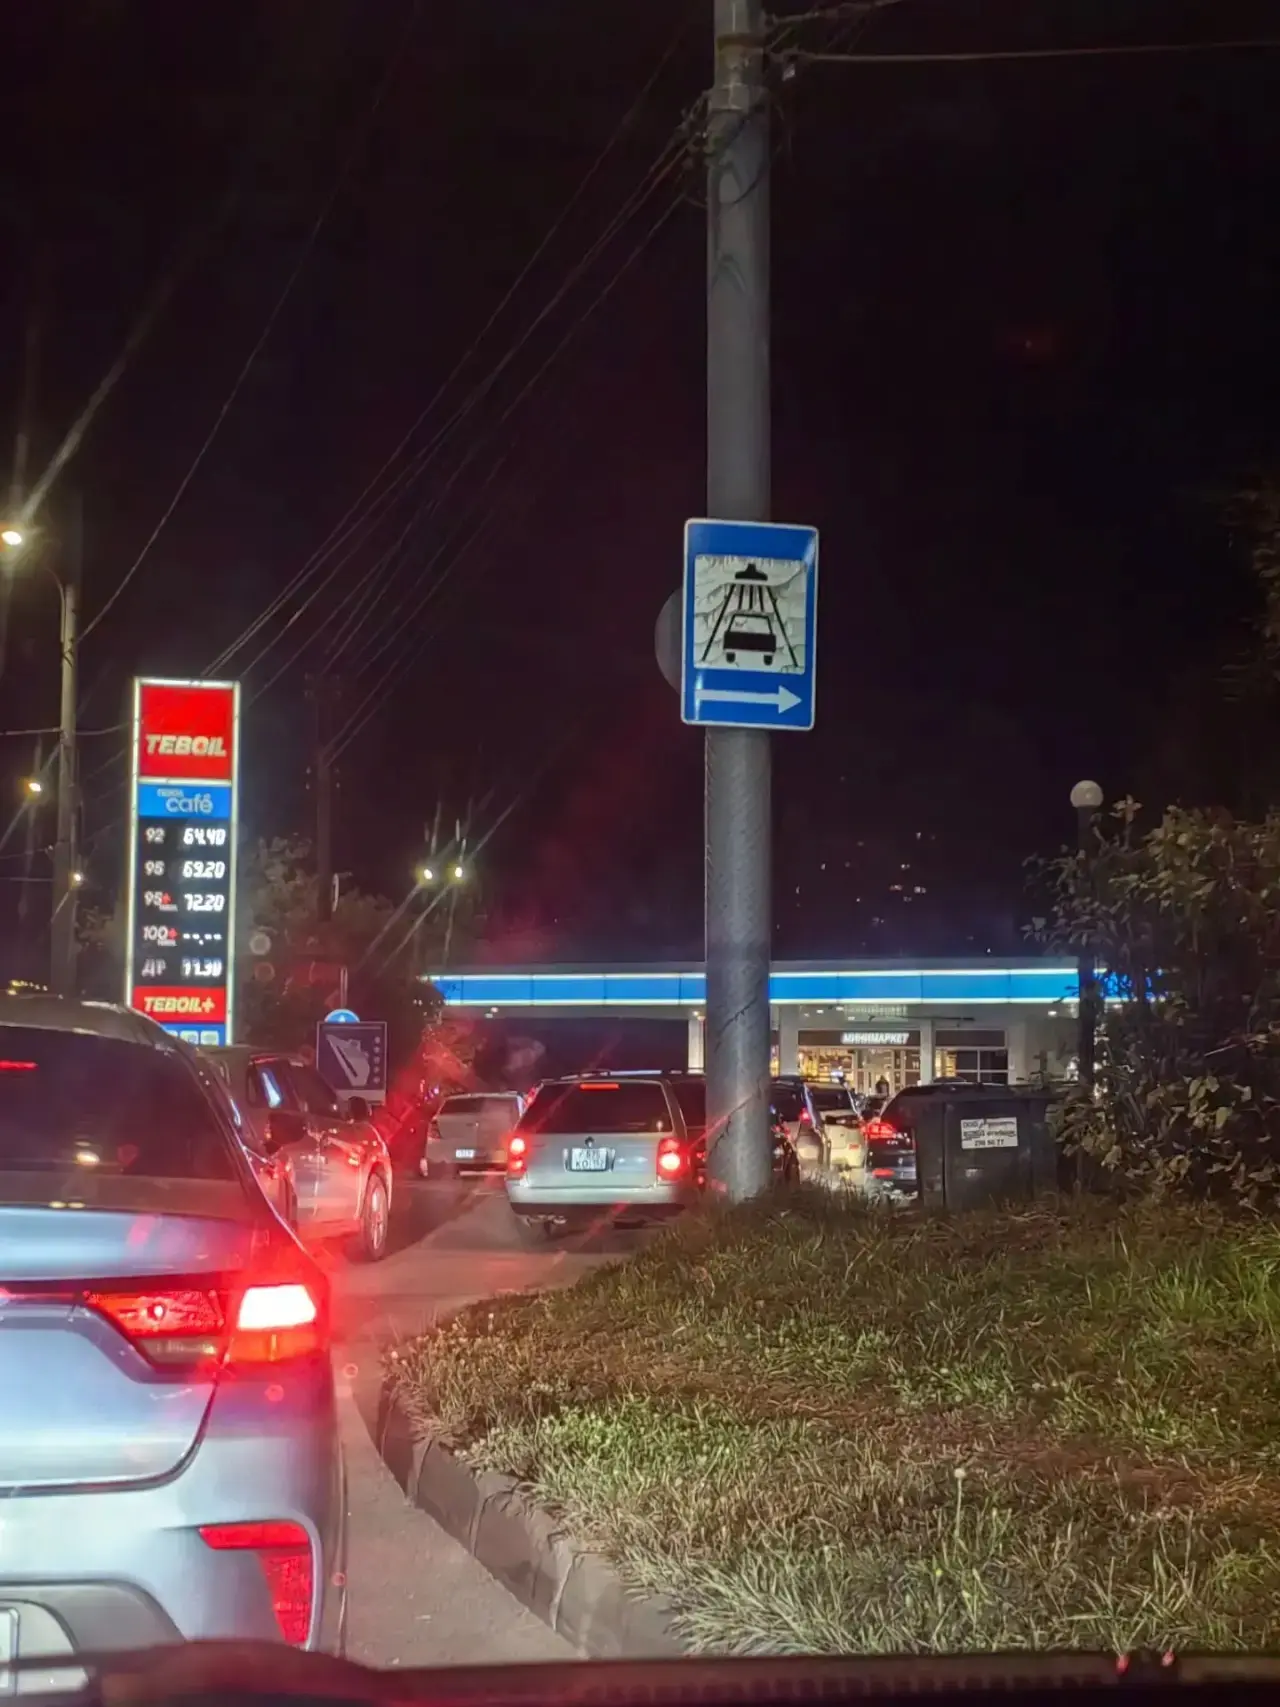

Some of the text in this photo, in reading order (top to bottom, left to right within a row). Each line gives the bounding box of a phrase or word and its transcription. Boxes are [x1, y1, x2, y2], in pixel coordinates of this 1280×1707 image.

[145, 735, 227, 757] TEBOIL
[166, 793, 213, 814] café
[145, 827, 165, 844] 92
[144, 860, 165, 876] 95
[842, 1032, 909, 1044] МИНИМАРКЕТ
